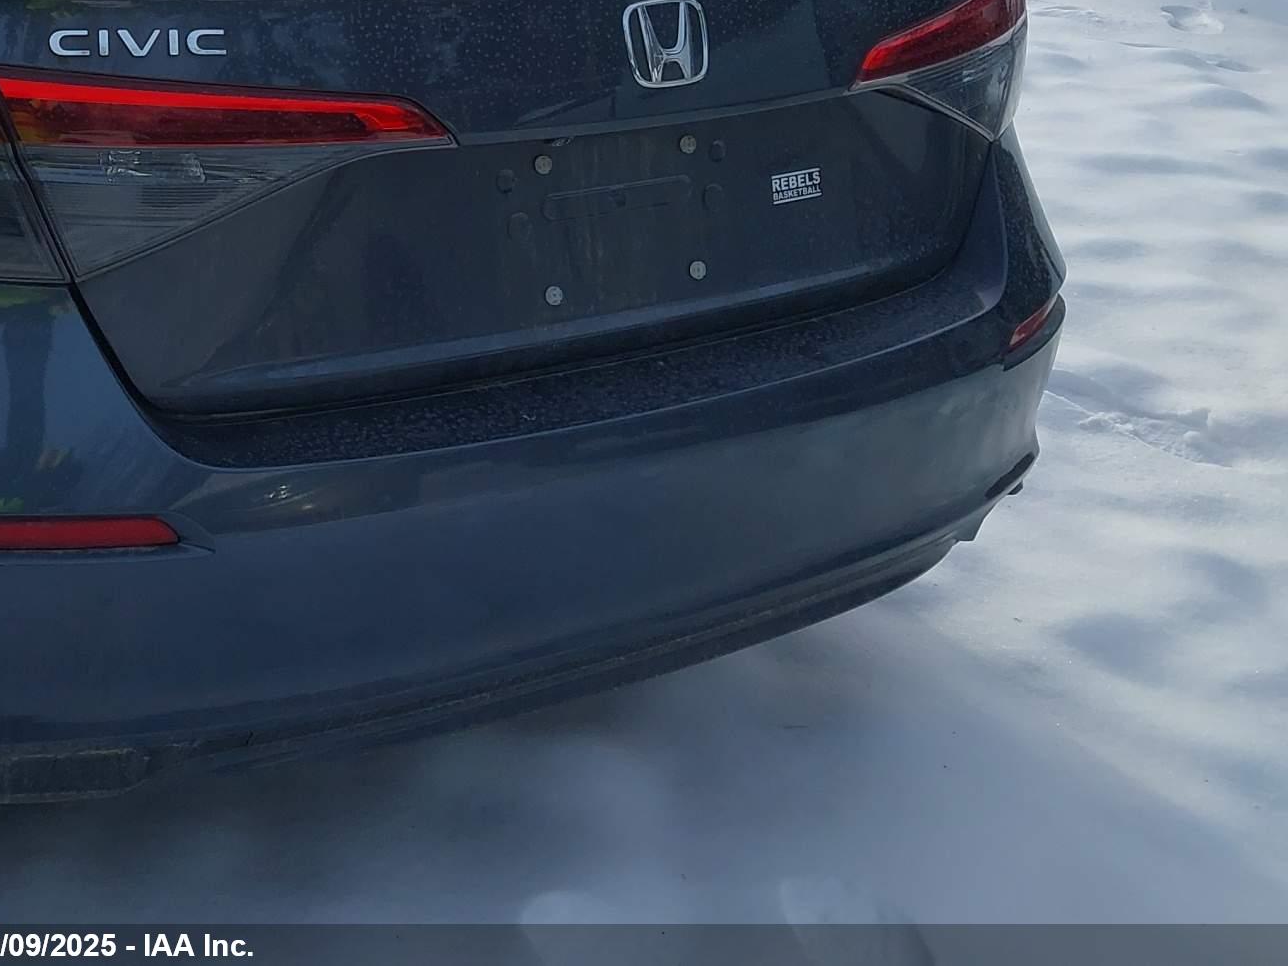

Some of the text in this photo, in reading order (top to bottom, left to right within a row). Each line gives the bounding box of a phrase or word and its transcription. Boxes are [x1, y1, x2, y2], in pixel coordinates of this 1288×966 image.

[48, 28, 228, 57] CIVIC
[771, 171, 821, 193] REBELS
[772, 184, 822, 201] BASKETBALL
